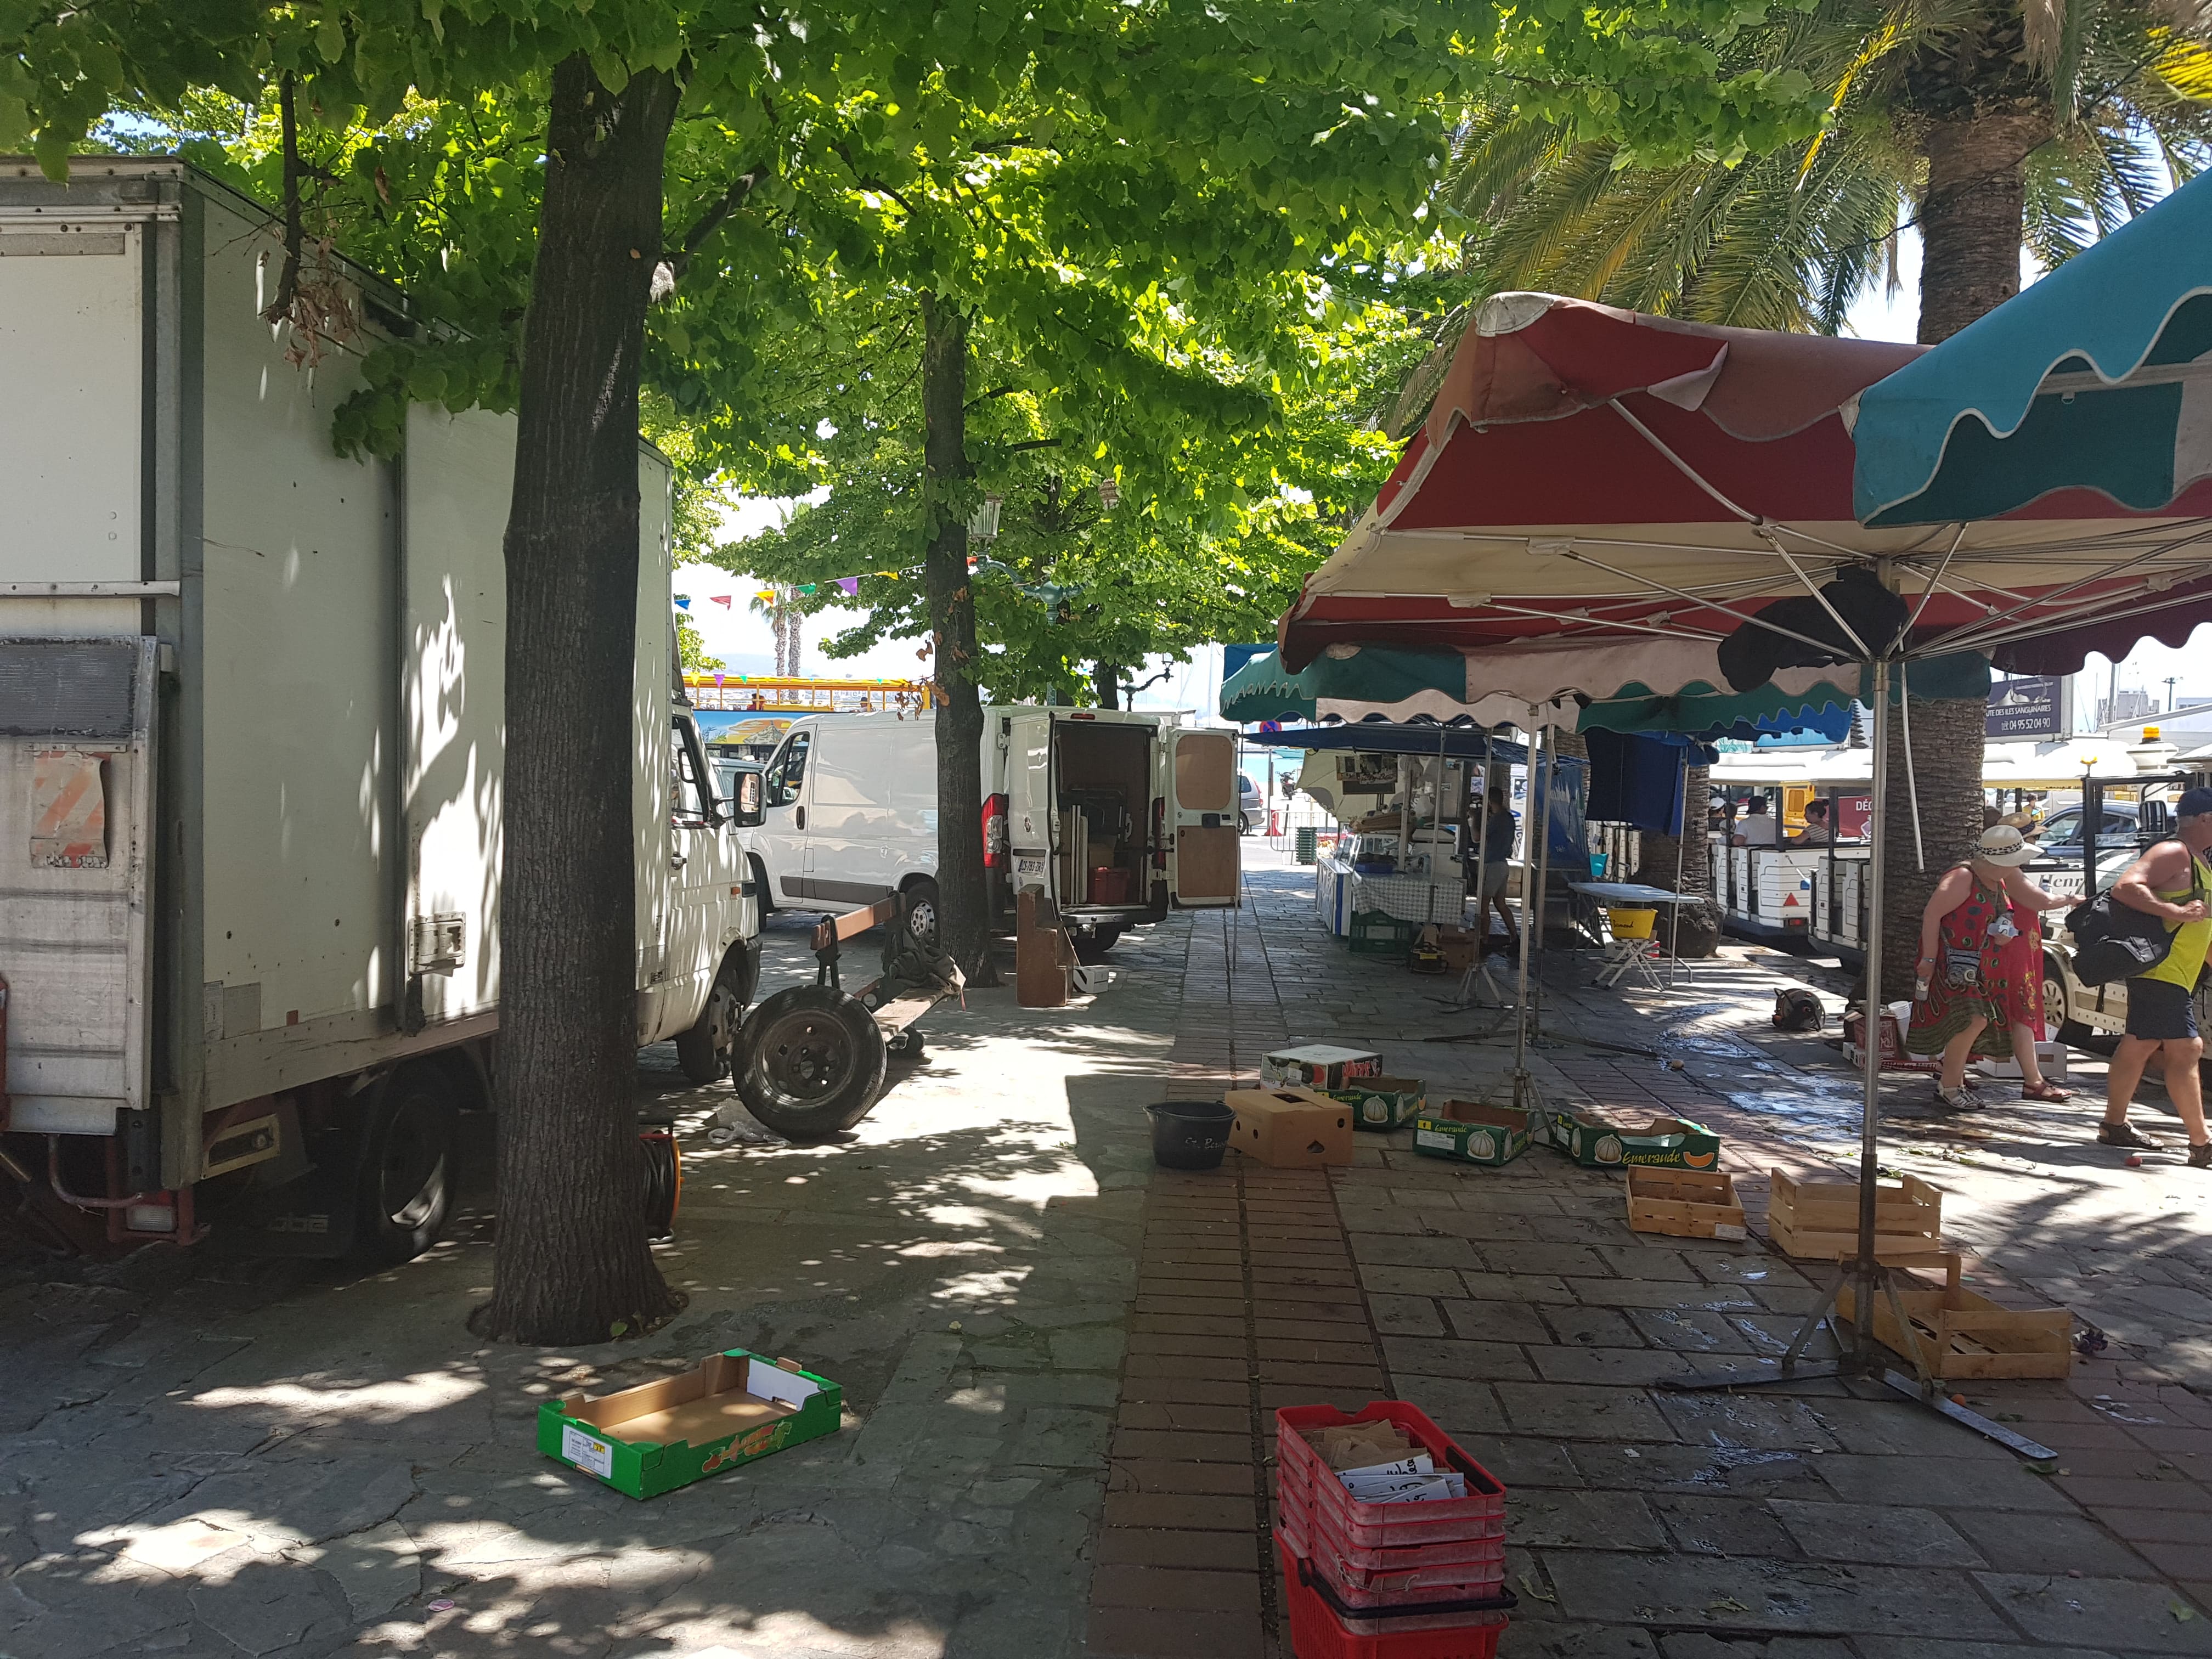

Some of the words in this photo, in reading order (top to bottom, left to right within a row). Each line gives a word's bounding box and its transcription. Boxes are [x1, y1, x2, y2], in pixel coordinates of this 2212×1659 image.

[2015, 704, 2051, 714] SANGUINAIRES
[2009, 720, 2016, 730] 04
[2017, 719, 2025, 730] 95
[2025, 718, 2033, 729] 52
[2034, 718, 2041, 729] 04
[2042, 717, 2050, 727] 90
[1435, 1124, 1467, 1132] Emeraude
[1622, 1149, 1681, 1164] Emeraude
